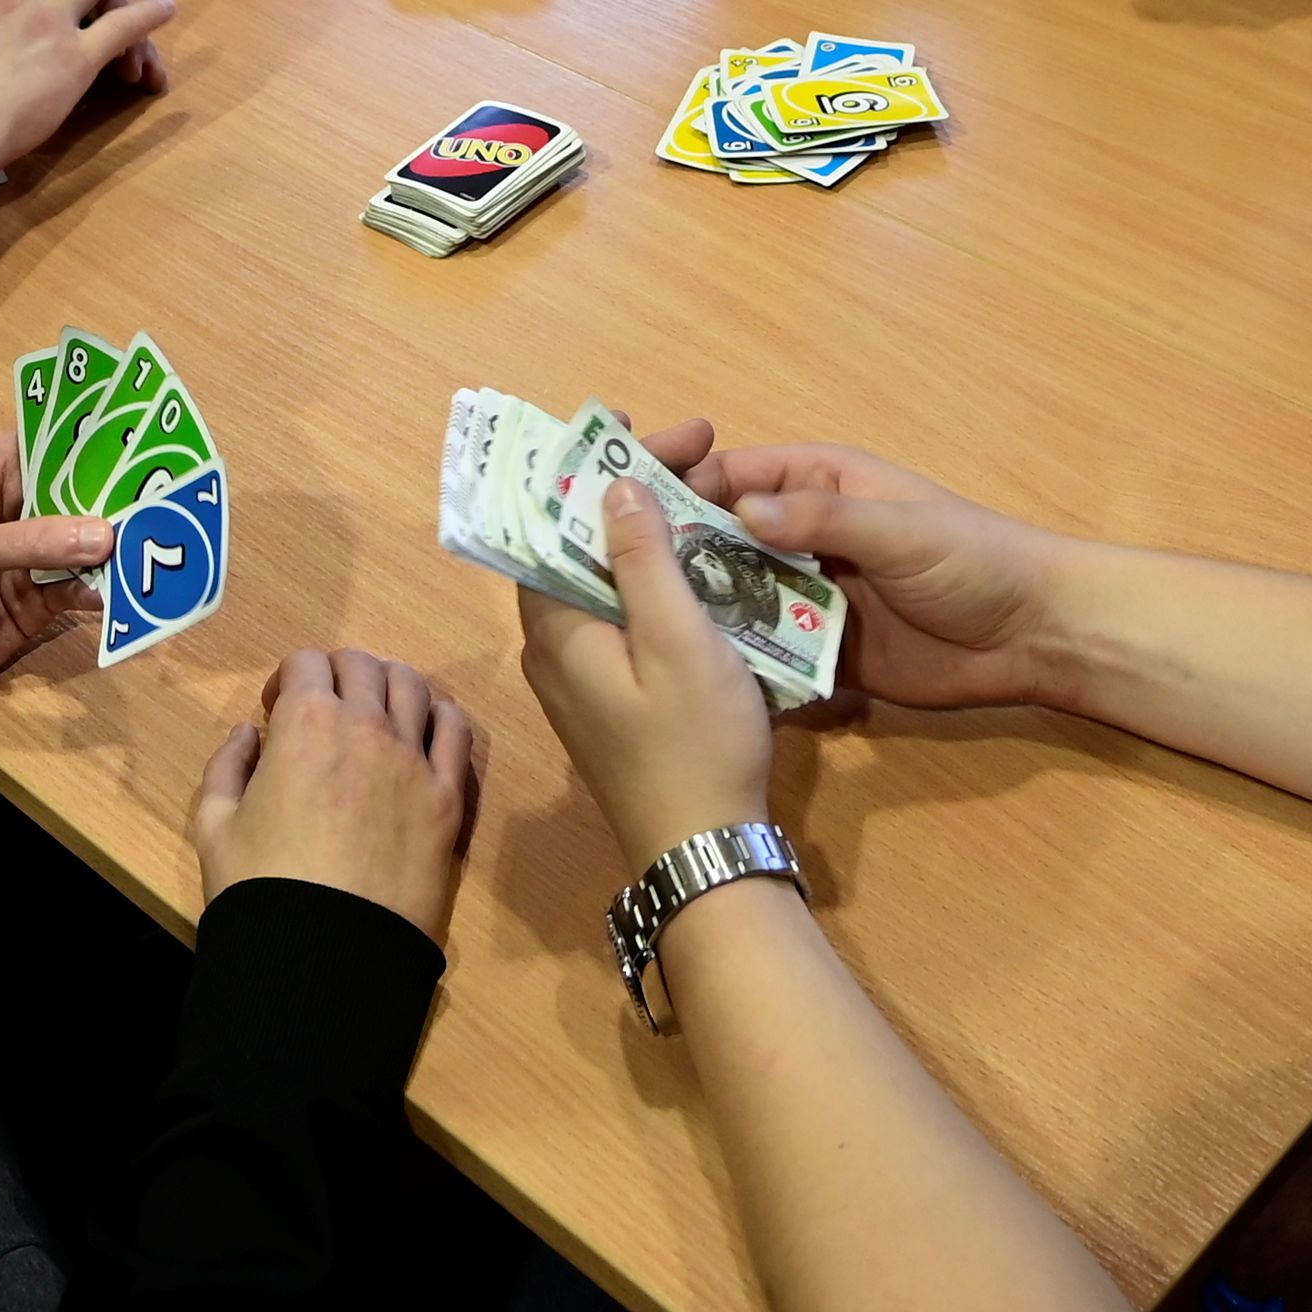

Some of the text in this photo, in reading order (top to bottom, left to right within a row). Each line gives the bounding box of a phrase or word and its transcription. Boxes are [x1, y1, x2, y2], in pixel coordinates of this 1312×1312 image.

[818, 91, 889, 115] 6
[430, 137, 533, 168] UNO
[723, 140, 752, 152] 6
[67, 347, 89, 384] 8
[133, 358, 153, 391] 1
[26, 368, 46, 406] 4
[160, 398, 182, 434] 0
[597, 438, 631, 479] 10
[196, 478, 219, 506] 7
[141, 536, 185, 599] 7
[109, 619, 130, 647] 7
